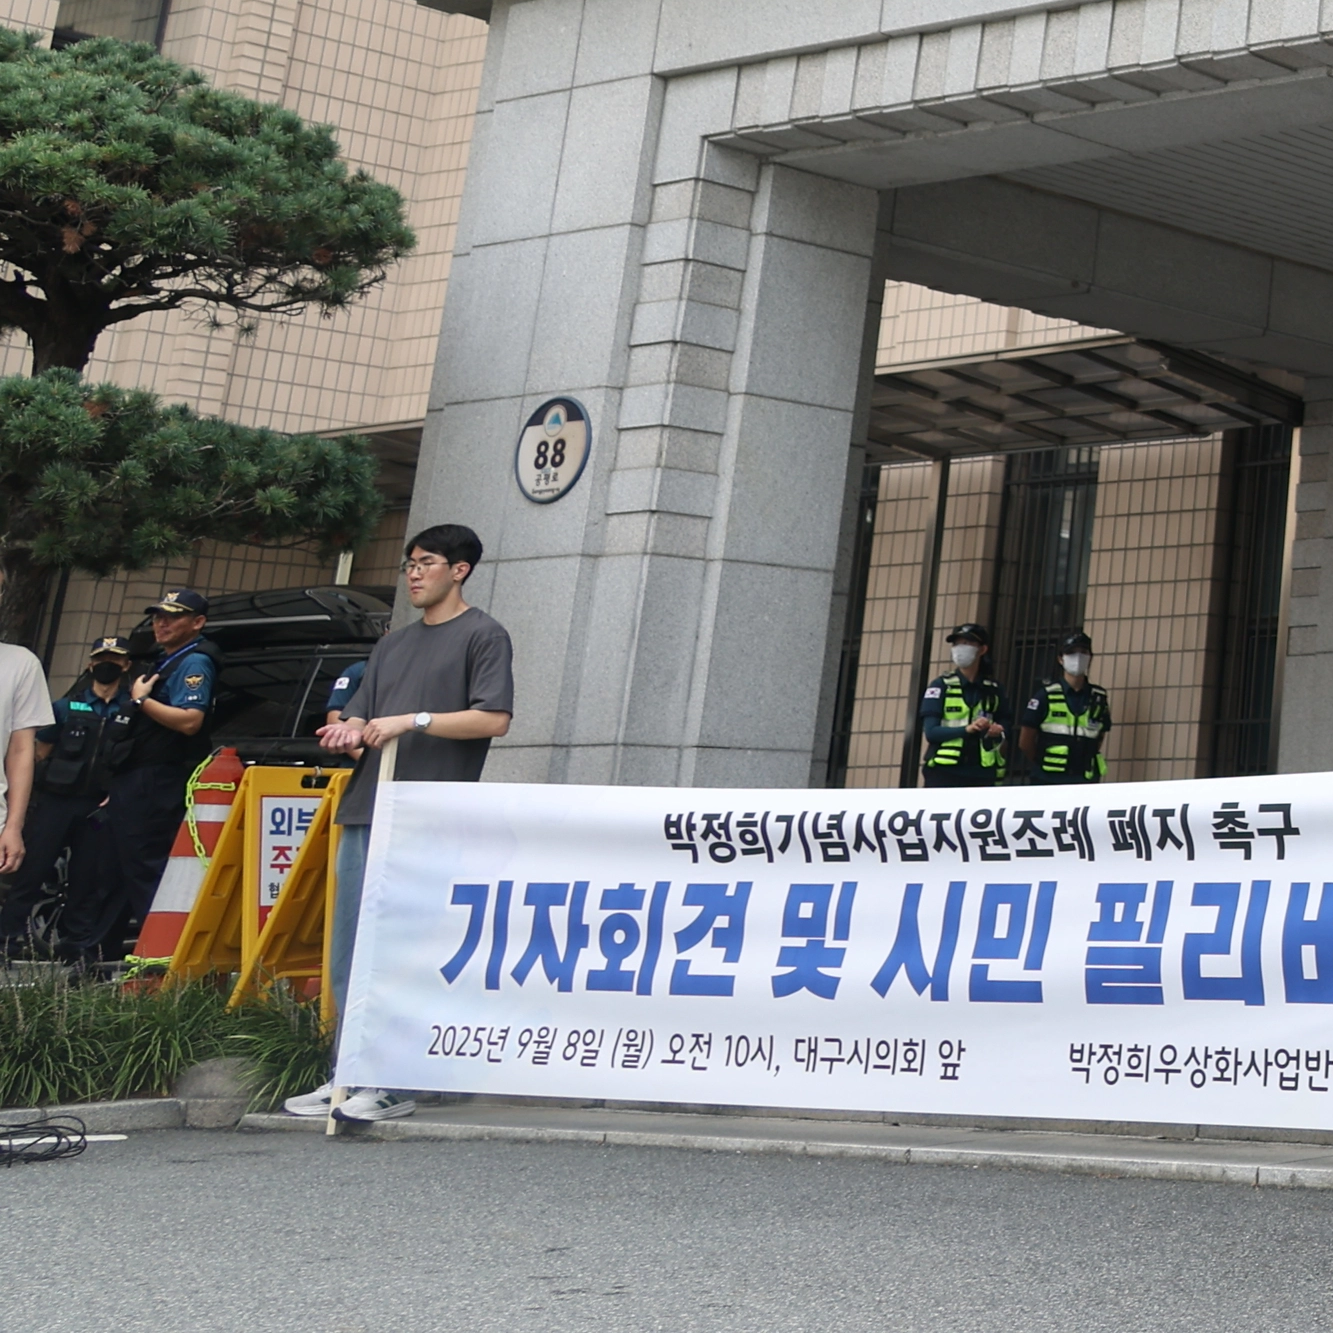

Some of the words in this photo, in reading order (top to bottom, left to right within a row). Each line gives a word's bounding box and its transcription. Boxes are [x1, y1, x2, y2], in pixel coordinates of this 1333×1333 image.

[534, 438, 566, 469] 88
[664, 806, 1095, 863] 박정희기념사업지원조례
[1107, 804, 1194, 861] 폐지
[1212, 802, 1300, 860] 촉구
[440, 881, 751, 996] 기자회견
[772, 882, 857, 1000] 및
[870, 881, 1057, 1003] 시민
[428, 1026, 510, 1062] 2025년
[518, 1027, 557, 1065] 9월
[563, 1029, 604, 1067] 8일
[612, 1028, 653, 1069] (월)
[661, 1033, 712, 1070] 오전
[725, 1035, 781, 1077] 10시,
[795, 1037, 925, 1075] 대구시의회
[939, 1040, 965, 1080] 앞
